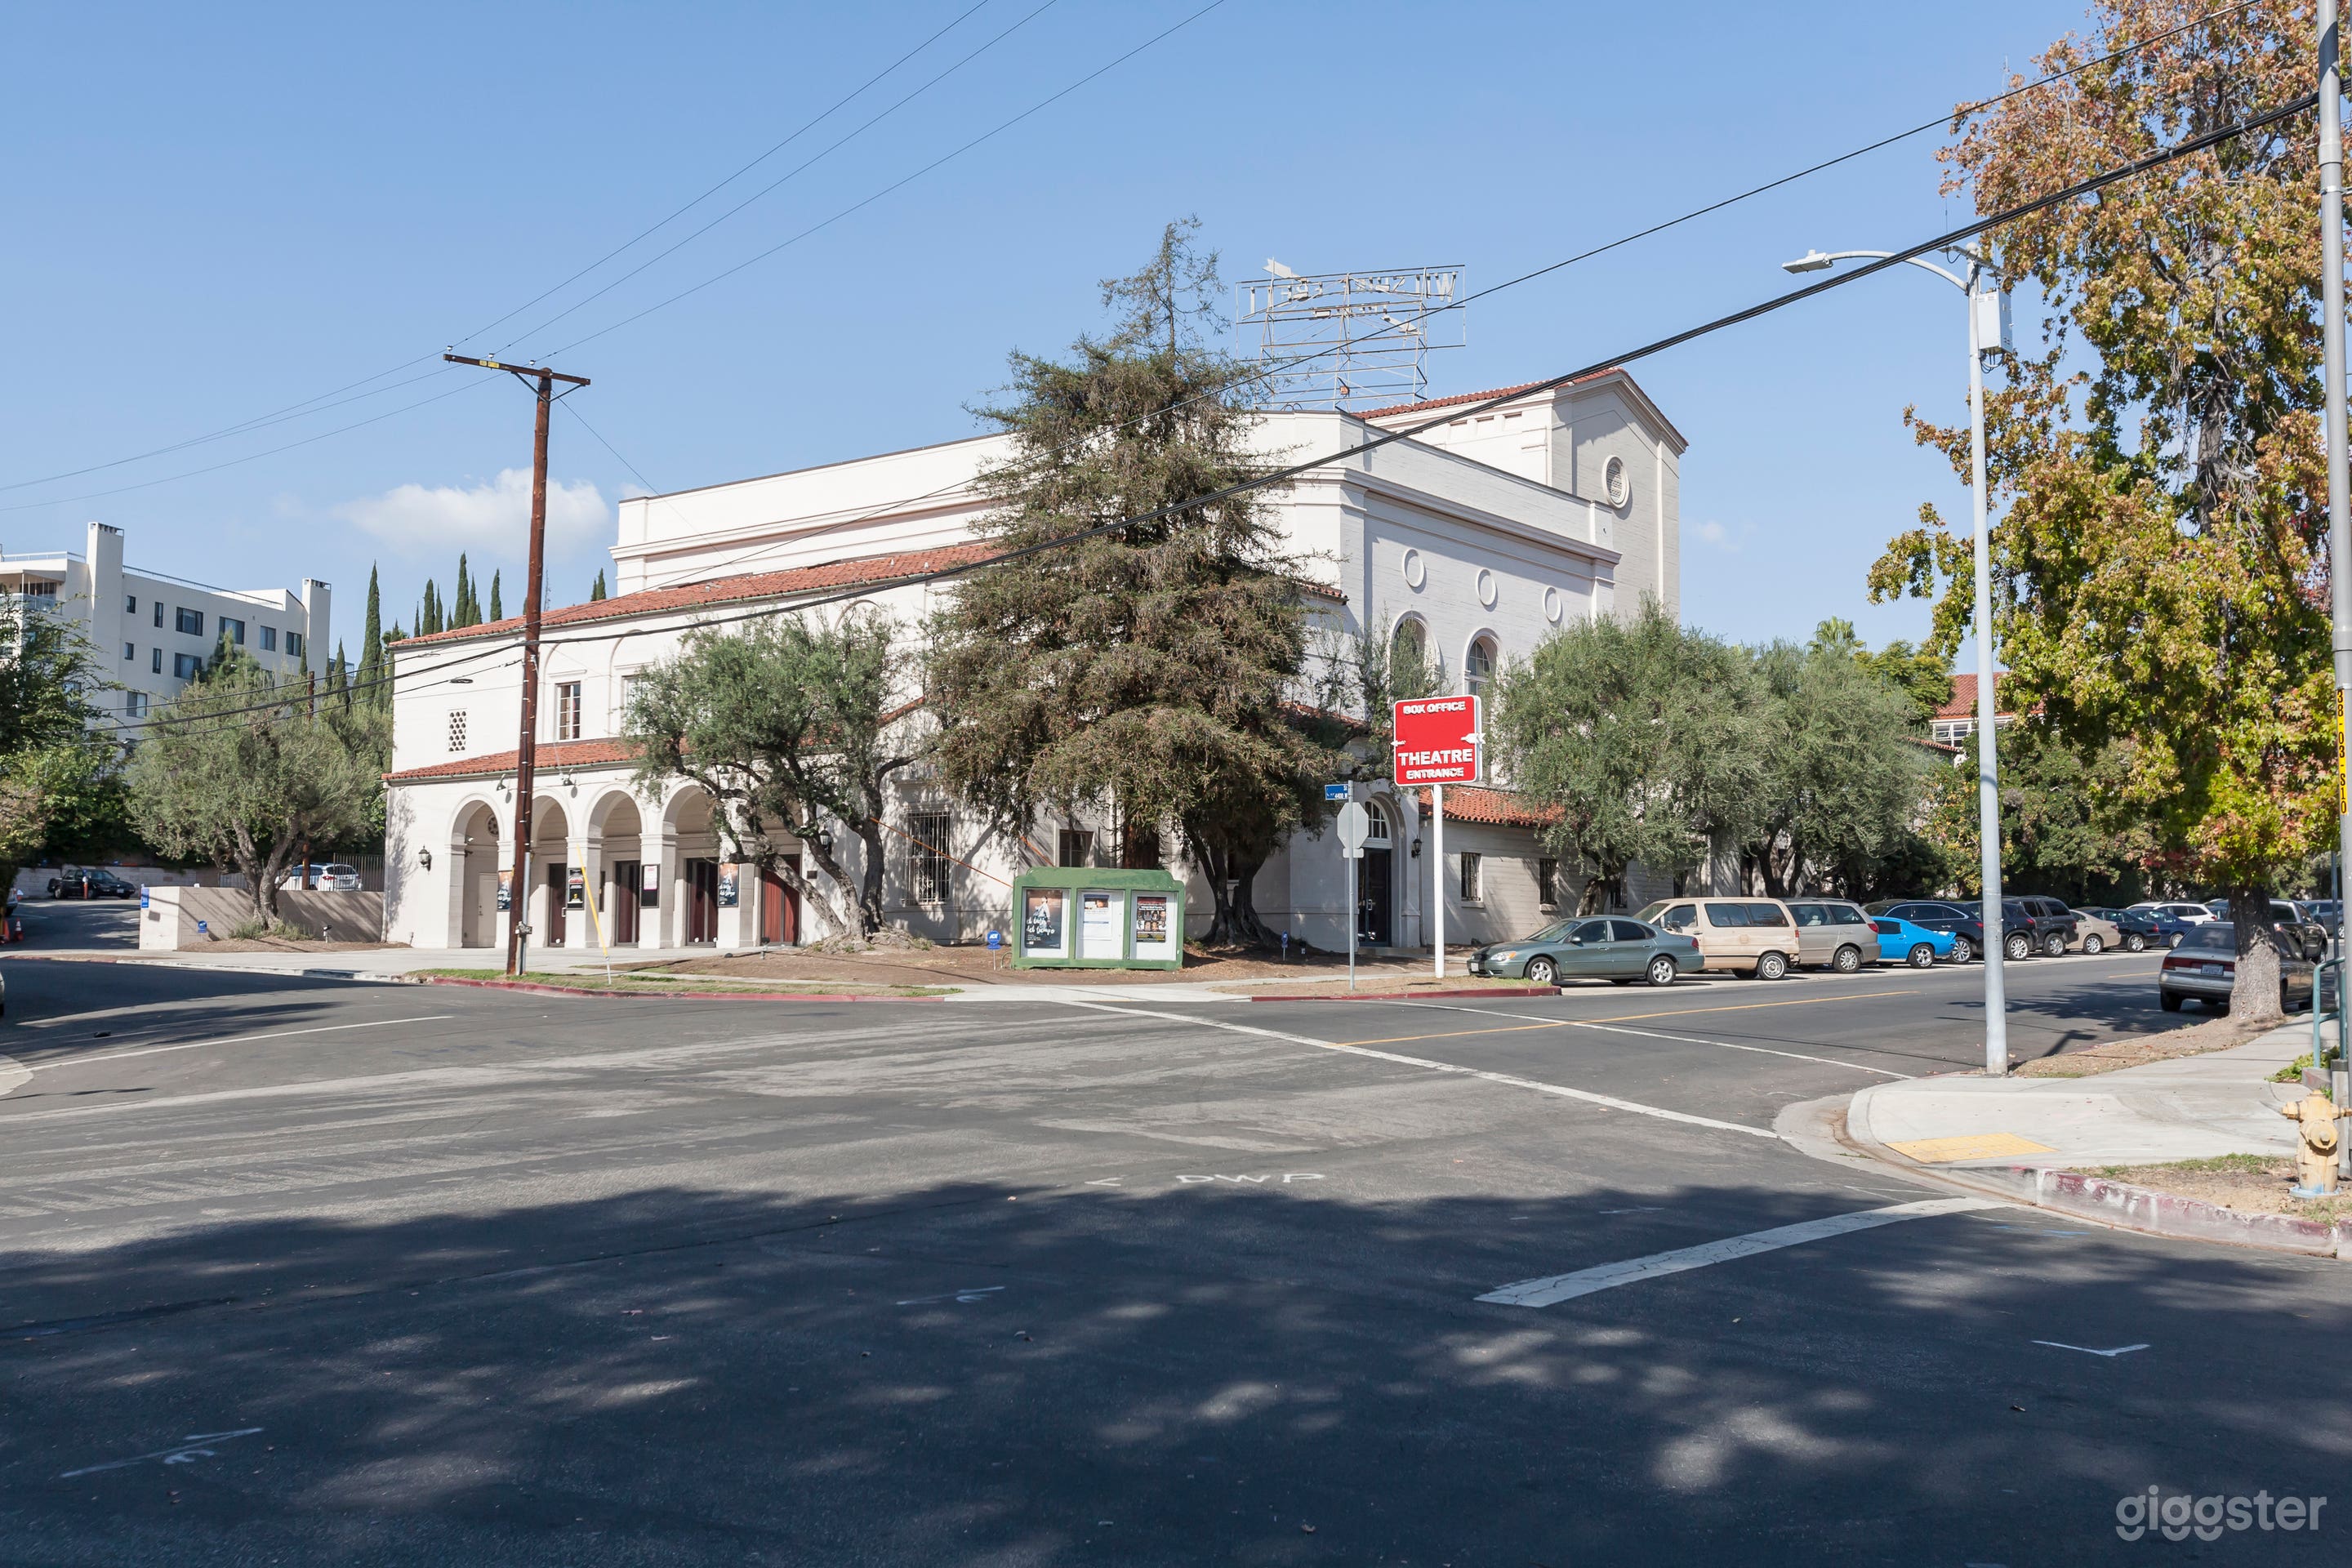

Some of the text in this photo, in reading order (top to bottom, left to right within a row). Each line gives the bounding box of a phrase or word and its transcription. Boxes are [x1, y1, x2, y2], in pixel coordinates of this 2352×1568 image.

[1403, 702, 1466, 715] BOX OFFICE
[1398, 749, 1472, 766] THEATRE
[1406, 768, 1464, 780] ENTRANCE
[1176, 1174, 1325, 1183] DWP
